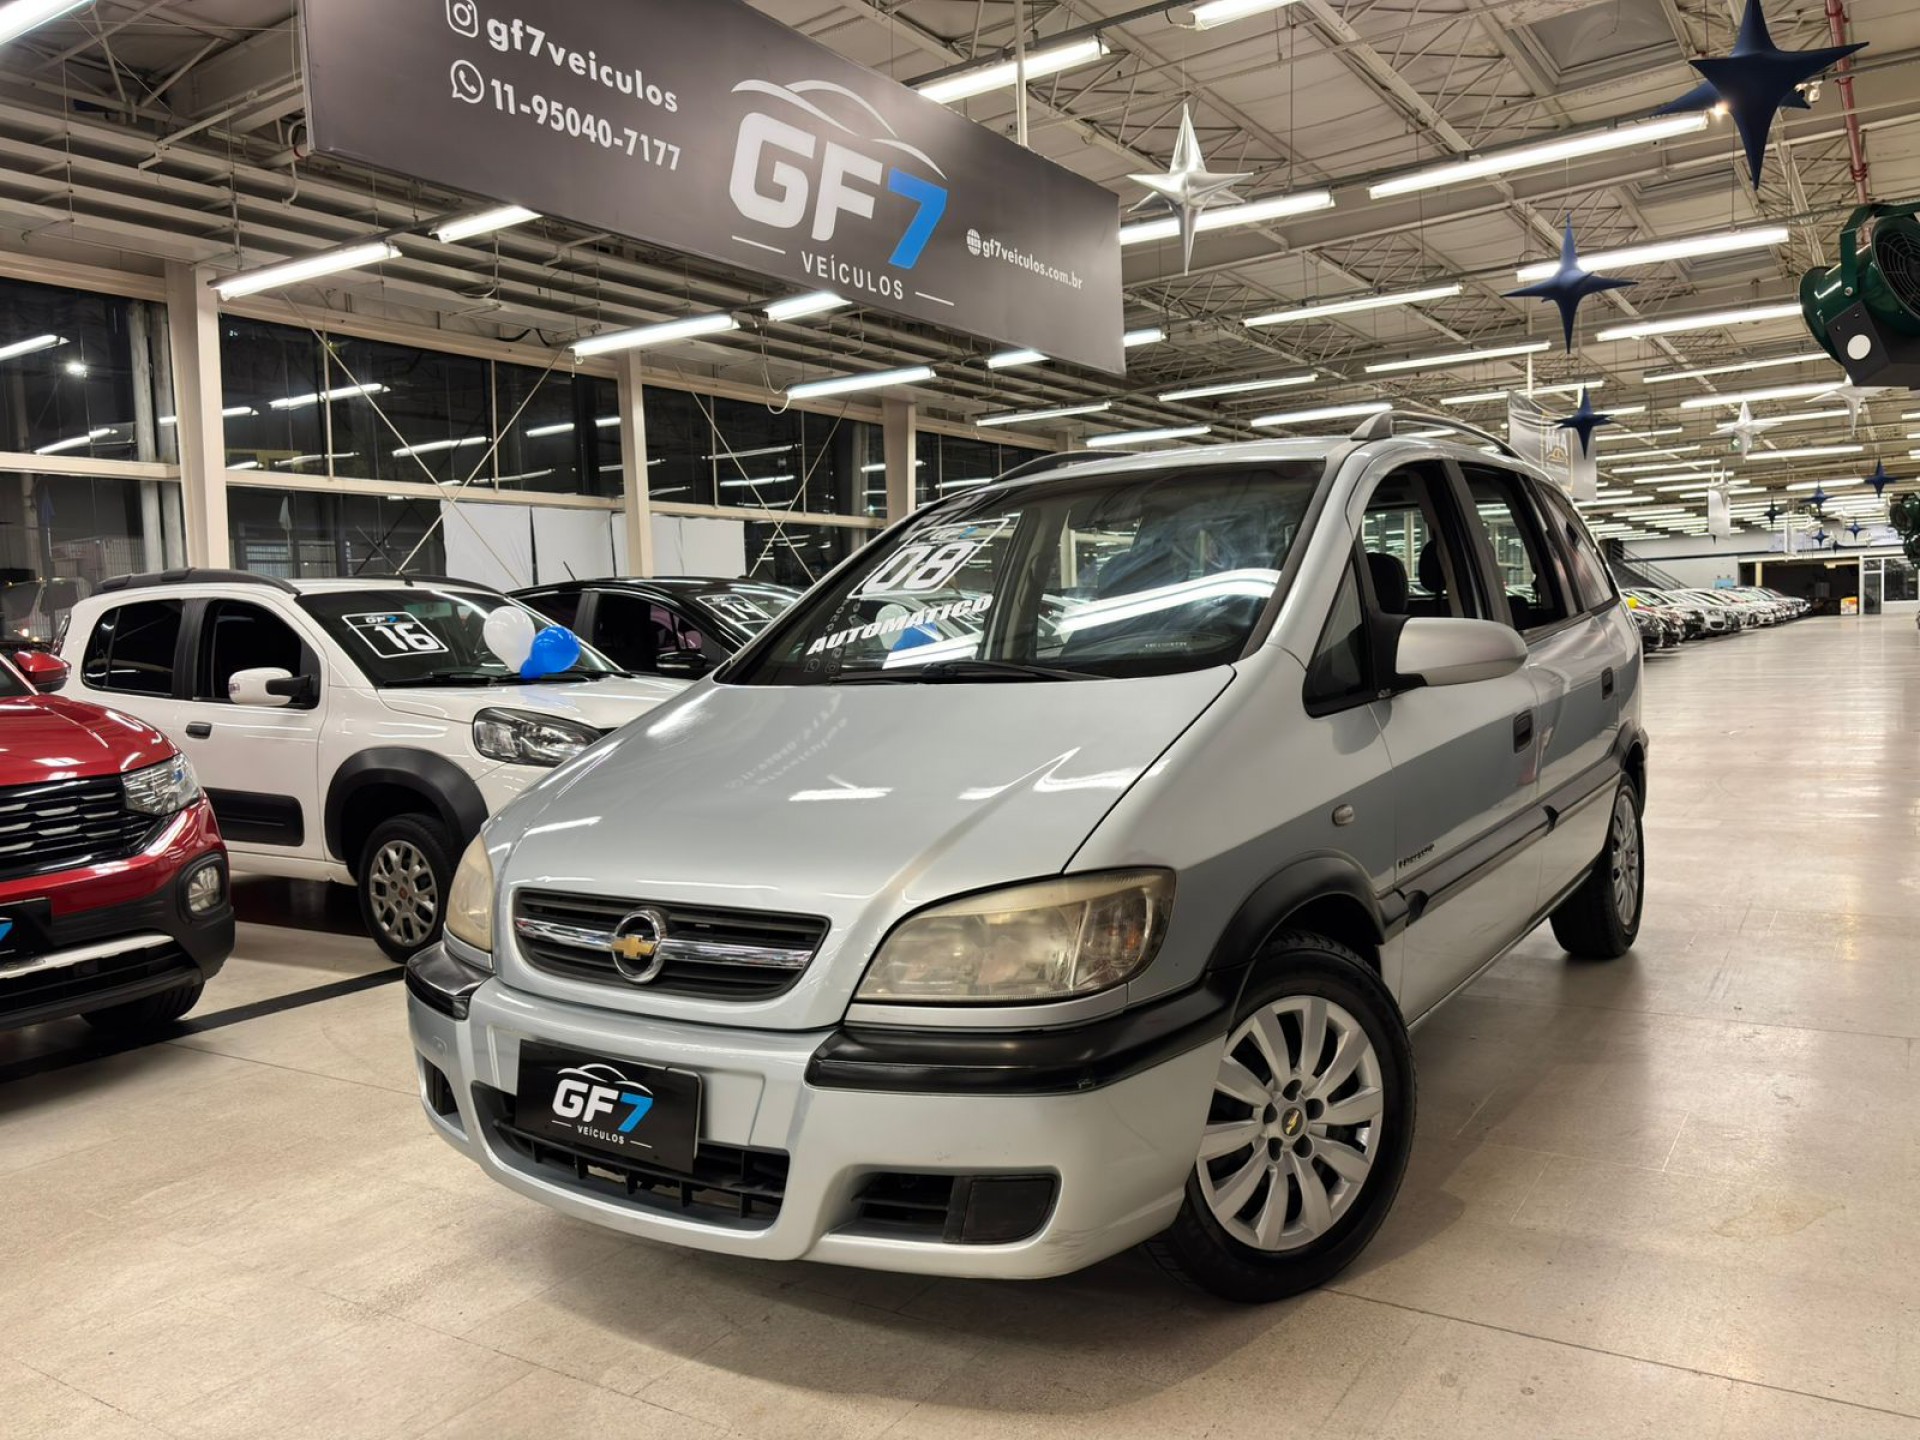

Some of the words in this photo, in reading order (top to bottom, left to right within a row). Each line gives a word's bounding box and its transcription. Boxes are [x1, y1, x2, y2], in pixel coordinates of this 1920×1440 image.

[486, 18, 679, 113] gf7veiculos
[490, 78, 681, 171] 11-95040-7177
[729, 111, 948, 269] GF7
[801, 250, 904, 300] VEÍCULOS
[982, 238, 1083, 291] gf7veiculos.com.br
[862, 541, 977, 593] 08
[374, 623, 440, 651] 16
[552, 1078, 654, 1133] GF7
[577, 1125, 625, 1145] VEÍCULOS
